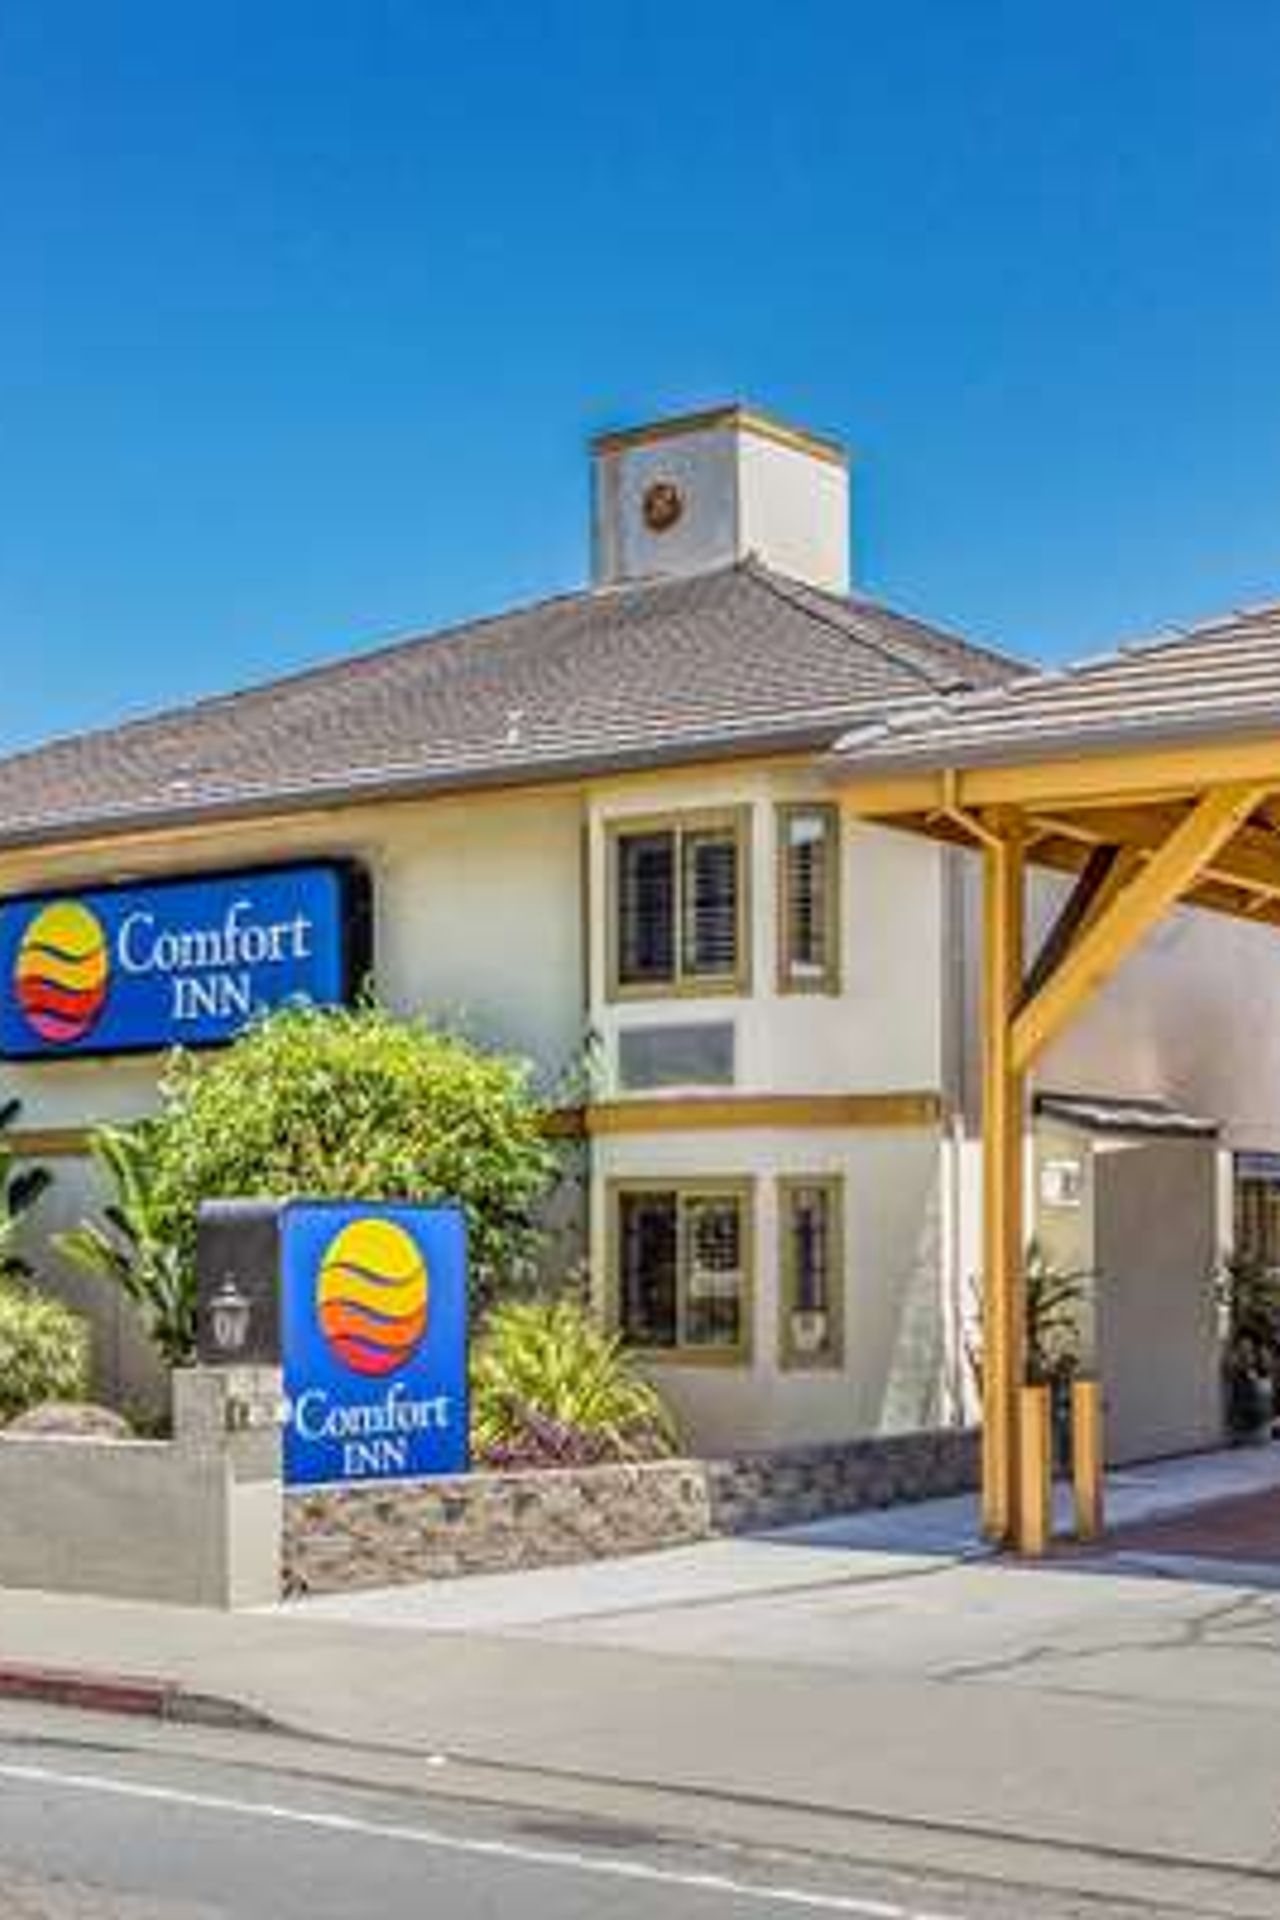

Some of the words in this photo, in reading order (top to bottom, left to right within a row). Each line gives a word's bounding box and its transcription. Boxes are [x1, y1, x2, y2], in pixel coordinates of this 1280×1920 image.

[118, 902, 313, 973] Comfort
[173, 974, 250, 1020] INN
[295, 1382, 452, 1440] Comfort
[343, 1438, 407, 1475] INN
